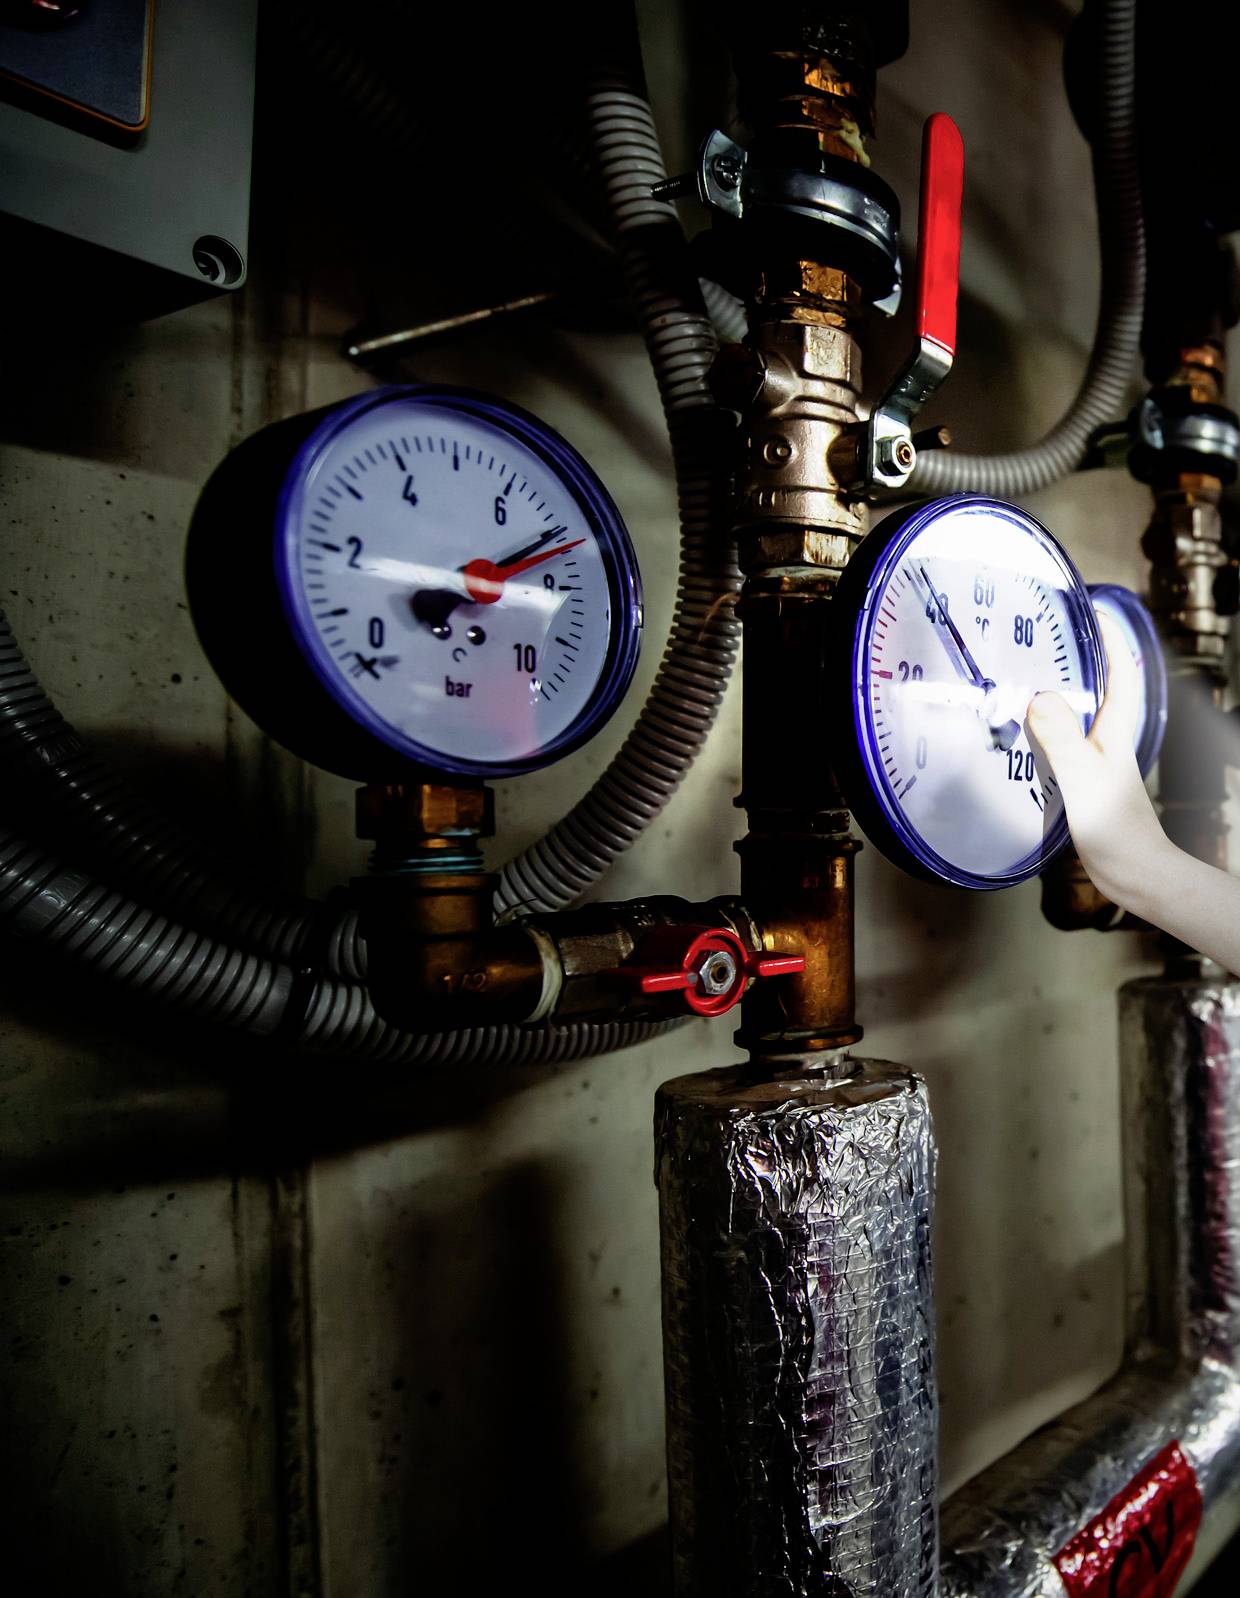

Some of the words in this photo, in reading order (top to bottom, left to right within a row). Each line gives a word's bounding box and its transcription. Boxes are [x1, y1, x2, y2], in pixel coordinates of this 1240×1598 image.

[403, 475, 418, 506] 4
[495, 496, 506, 526] 6
[347, 537, 362, 569] 2
[369, 617, 384, 649] 0
[1013, 614, 1034, 648] 80
[513, 643, 537, 674] 10
[445, 675, 473, 698] bar
[916, 736, 927, 770] 0
[1006, 750, 1034, 782] 120
